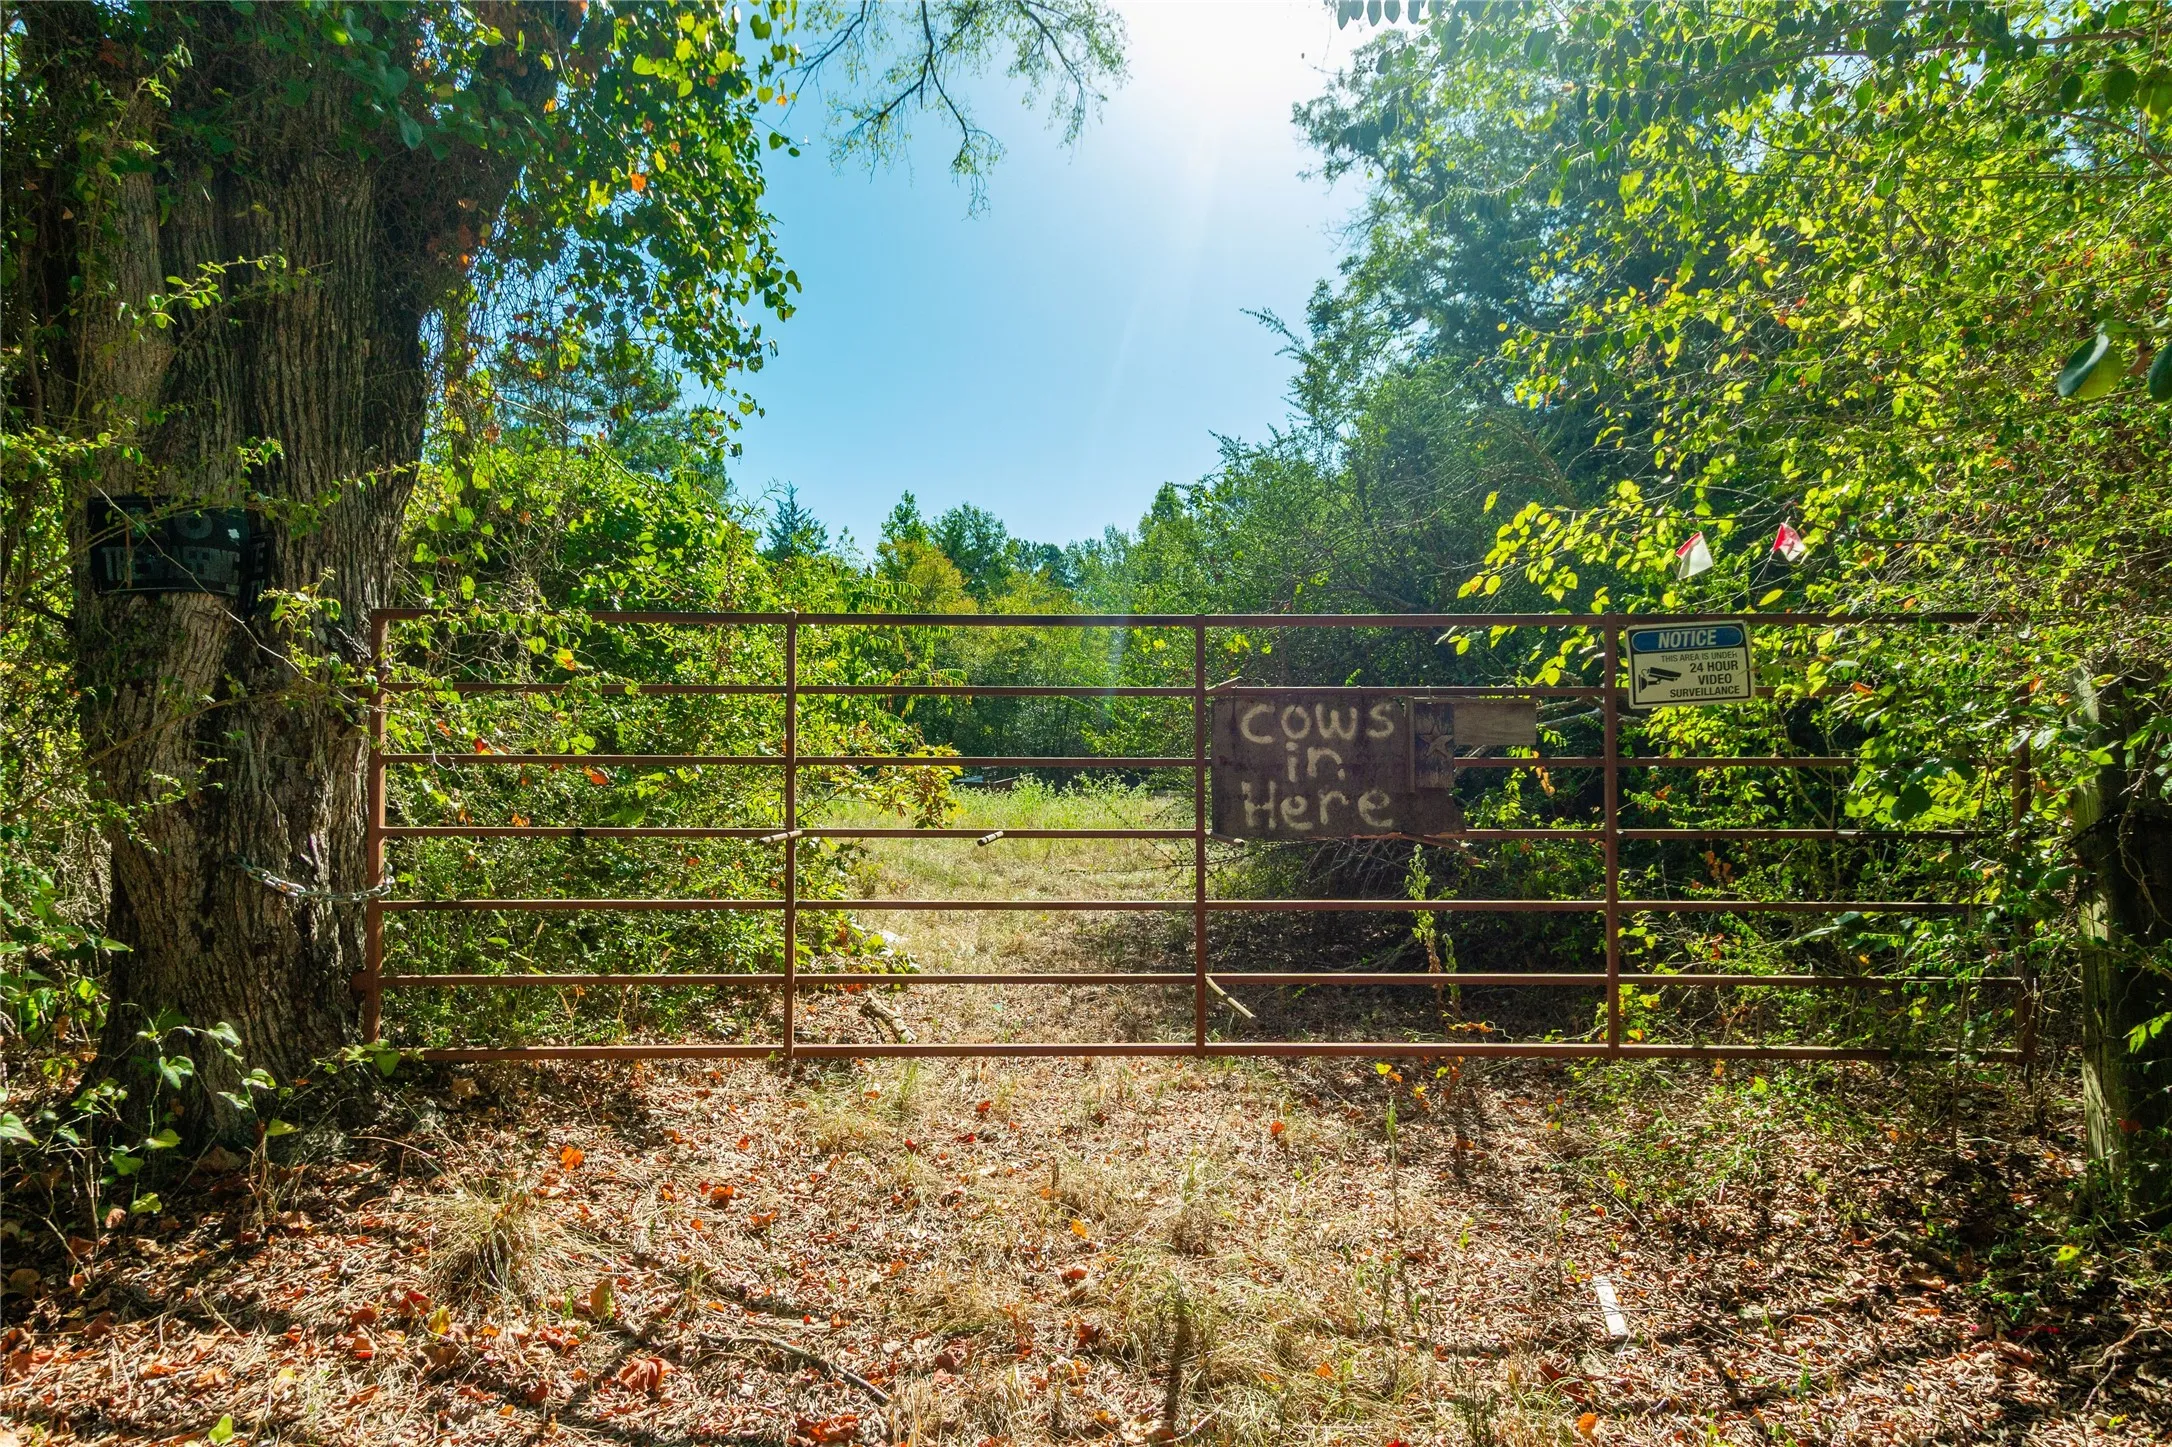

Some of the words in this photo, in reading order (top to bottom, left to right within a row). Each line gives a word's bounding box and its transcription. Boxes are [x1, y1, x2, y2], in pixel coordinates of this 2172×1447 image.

[1658, 629, 1717, 649] NOTICE
[1661, 655, 1679, 663] THIS
[1679, 653, 1700, 662] AREA
[1701, 652, 1710, 660] IS
[1711, 651, 1738, 660] UNDER
[1689, 662, 1704, 673] 24
[1707, 660, 1738, 672] HOUR
[1698, 673, 1732, 685] VIDEO
[1670, 685, 1740, 698] SURVEILLANCE
[1285, 741, 1346, 783] in
[1241, 780, 1393, 831] Here
